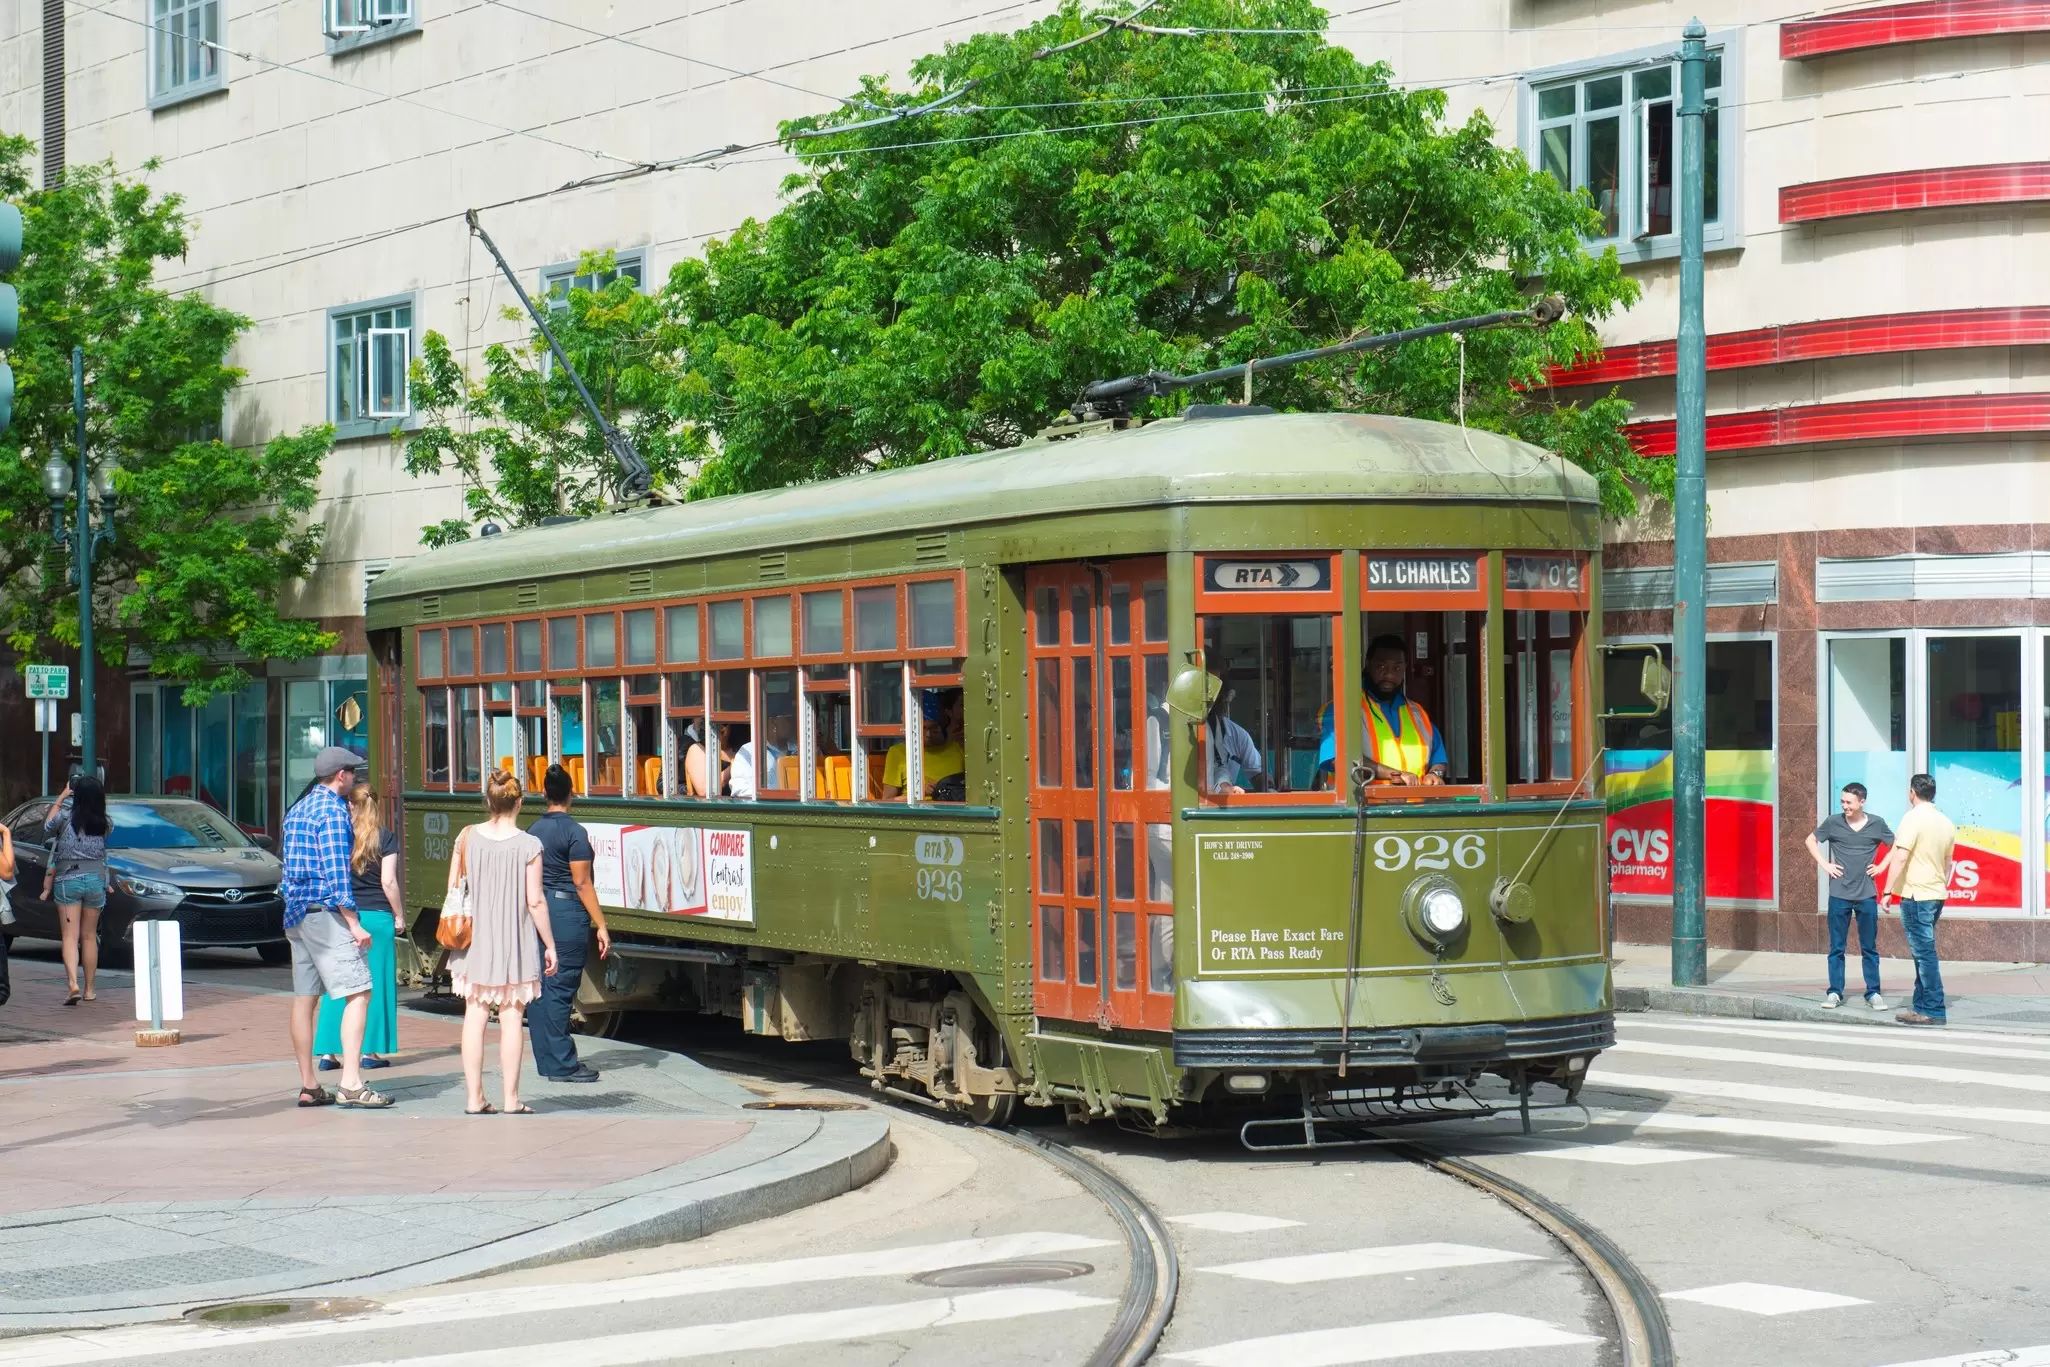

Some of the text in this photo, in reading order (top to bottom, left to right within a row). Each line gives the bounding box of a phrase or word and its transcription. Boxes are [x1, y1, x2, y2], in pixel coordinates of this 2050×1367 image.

[1235, 568, 1274, 583] RTA
[1369, 561, 1471, 584] ST. CHARLES
[35, 675, 40, 683] 2
[424, 836, 449, 861] 926
[709, 832, 745, 857] COMPARE
[924, 841, 942, 858] RTA
[1204, 840, 1263, 850] HOW'S MY DRIVING
[1373, 834, 1486, 872] 926
[1611, 828, 1669, 863] CVS
[1212, 851, 1230, 860] CALL
[710, 858, 745, 888] Contrast
[1610, 862, 1667, 880] pharmacy
[916, 868, 963, 903] 926
[711, 888, 749, 919] enjoy!
[1211, 928, 1344, 942] Please Have Exact Fare
[1211, 946, 1323, 960] Or RTA Pass Ready
